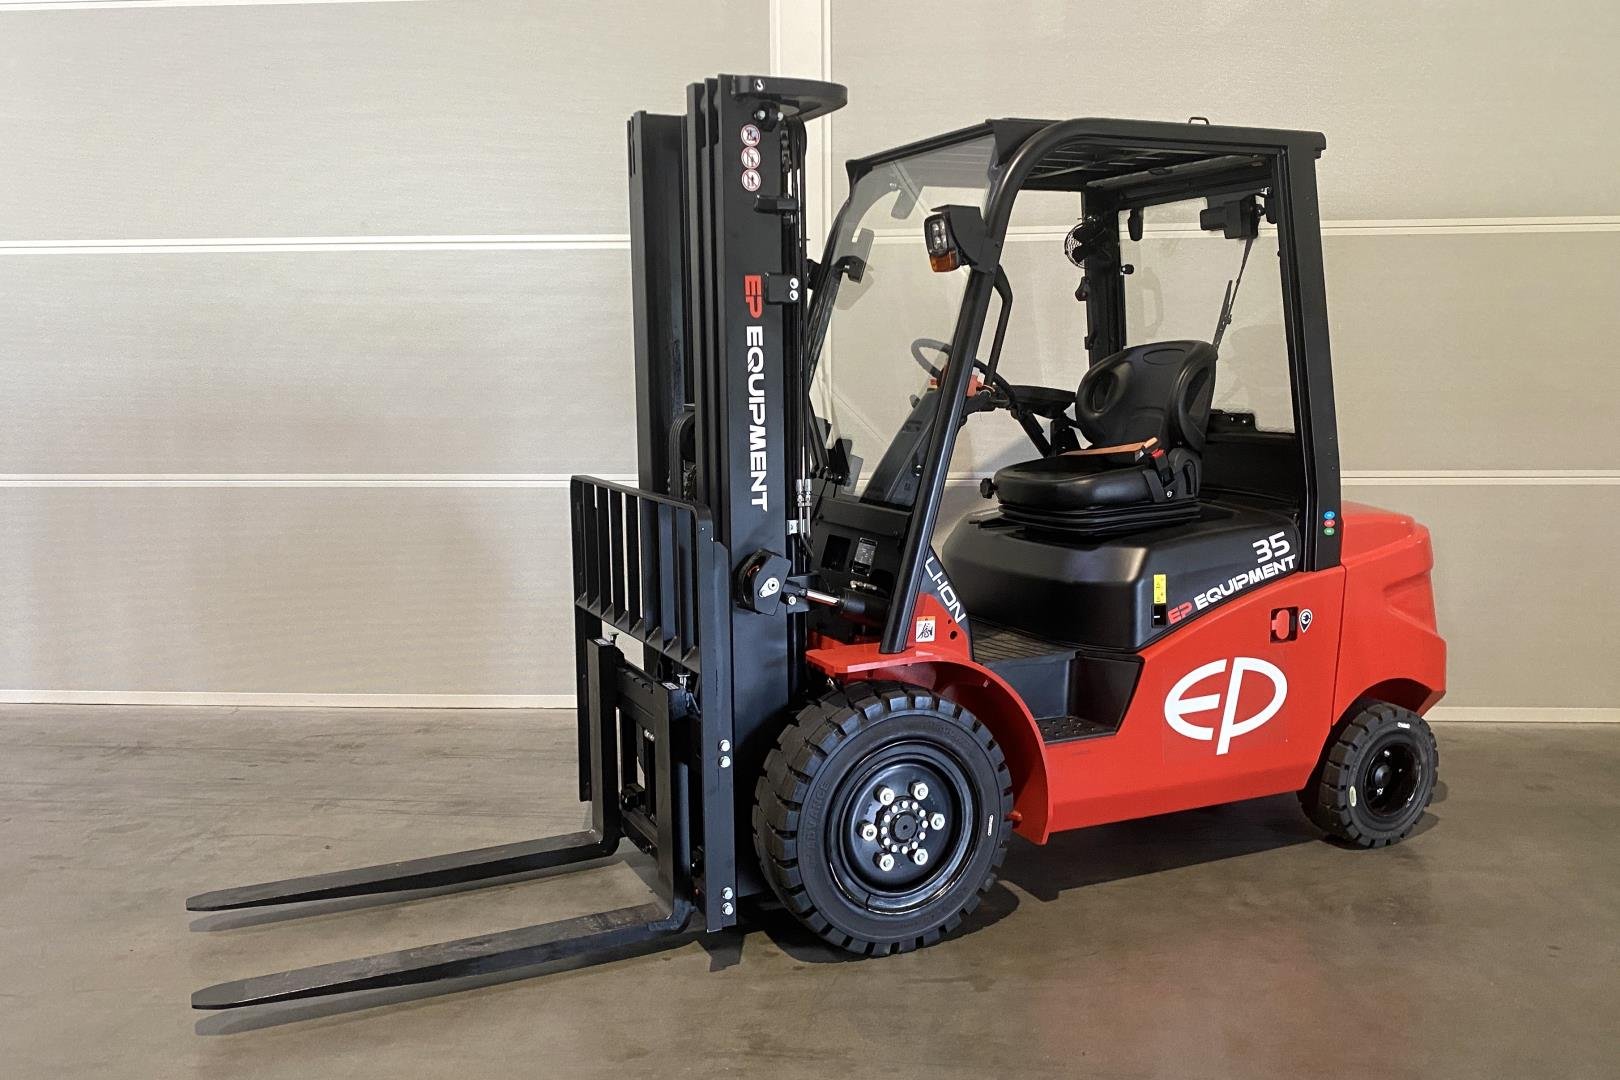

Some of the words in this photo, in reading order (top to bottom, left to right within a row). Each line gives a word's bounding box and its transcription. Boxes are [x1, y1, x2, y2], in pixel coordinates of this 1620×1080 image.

[744, 275, 763, 319] EP
[746, 325, 768, 512] EQUIPMENT
[1252, 531, 1291, 564] 35
[1167, 601, 1193, 625] EP
[1193, 554, 1296, 611] EQUIPMENT
[1164, 656, 1288, 756] EP
